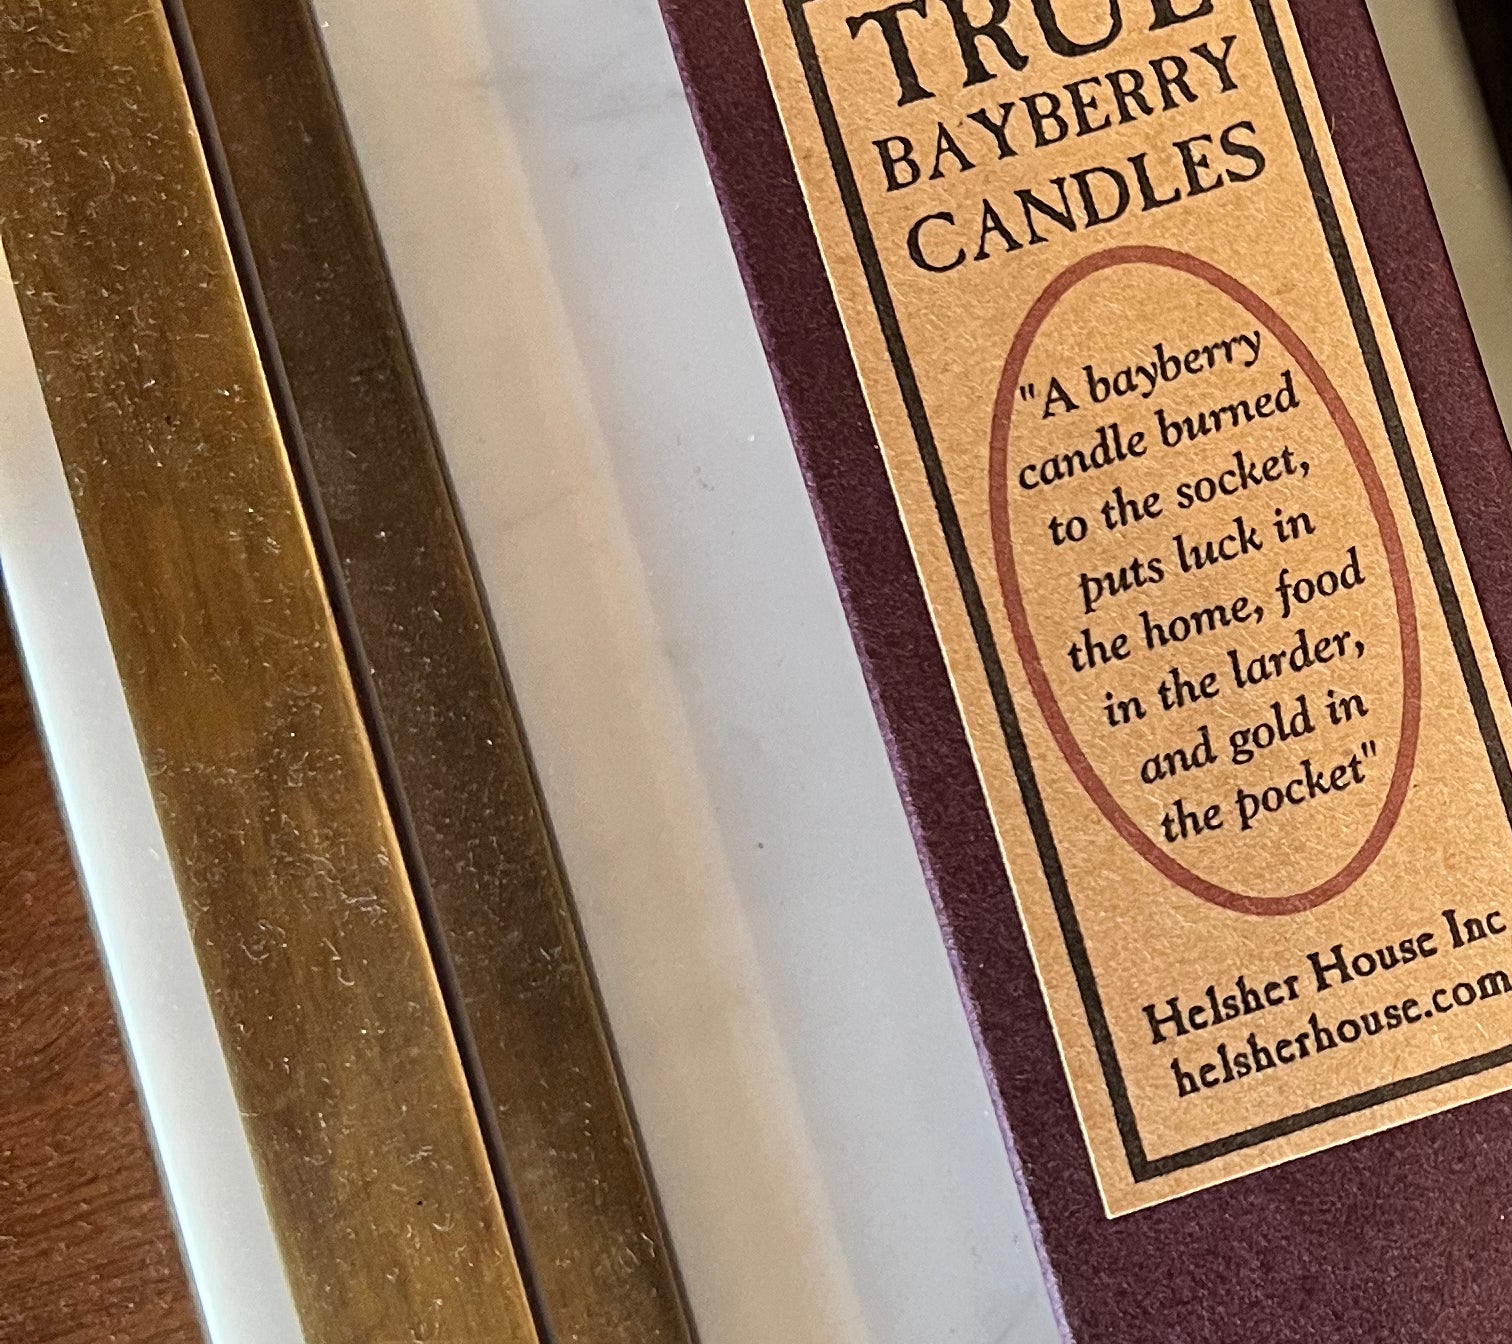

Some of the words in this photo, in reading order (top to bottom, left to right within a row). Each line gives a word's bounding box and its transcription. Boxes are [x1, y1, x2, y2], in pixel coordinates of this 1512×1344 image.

[873, 36, 1238, 192] BAYBERRY
[907, 121, 1266, 273] CANDLES
[1019, 376, 1079, 420] "A
[1083, 331, 1262, 403] bayberry
[1019, 424, 1147, 490] candle
[1155, 370, 1300, 449] burned
[1049, 512, 1088, 546] to
[1102, 487, 1164, 531] the
[1177, 444, 1311, 510] socket,
[1068, 630, 1131, 673] the
[1140, 590, 1264, 649] home,
[1275, 546, 1366, 619] food
[1078, 559, 1165, 614] puts
[1173, 517, 1264, 574] luck
[1273, 508, 1316, 545] in
[1103, 690, 1147, 728] in
[1157, 667, 1220, 711] the
[1227, 626, 1365, 689] larder,
[1140, 726, 1218, 784] and
[1228, 696, 1315, 763] gold
[1325, 689, 1369, 726] in
[1160, 800, 1224, 844] the
[1235, 739, 1378, 830] pocket"
[1141, 973, 1300, 1045] Helsher
[1307, 928, 1438, 992] House
[1440, 907, 1508, 950] Inc
